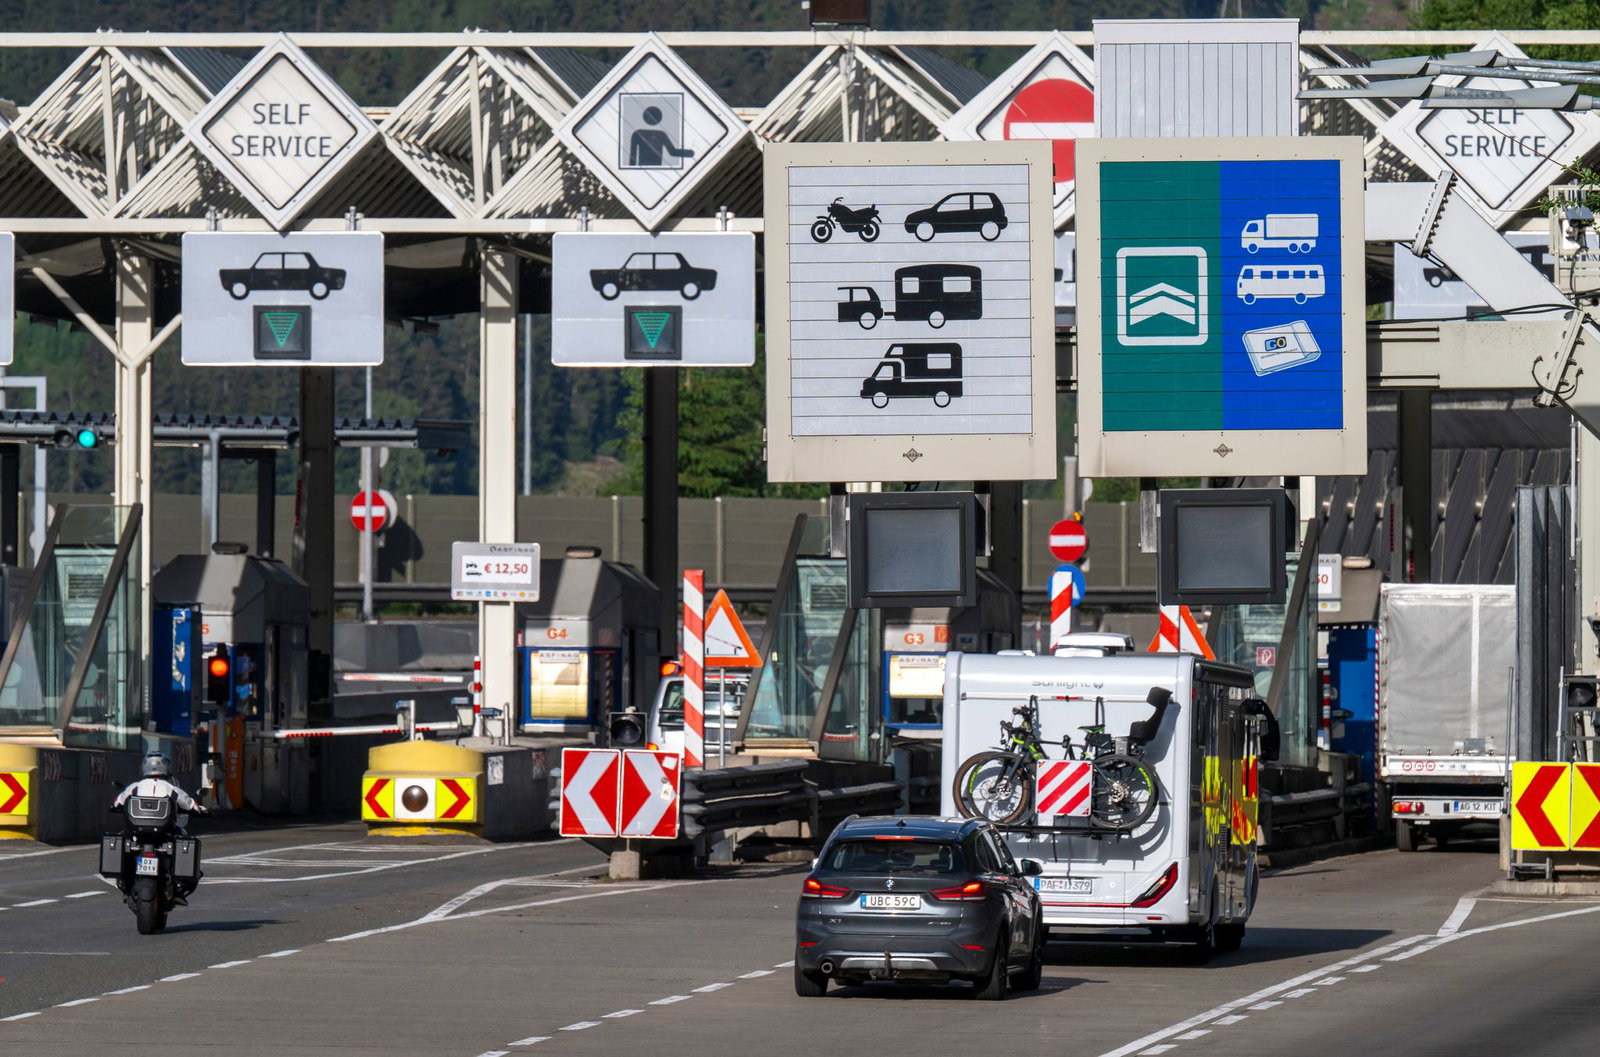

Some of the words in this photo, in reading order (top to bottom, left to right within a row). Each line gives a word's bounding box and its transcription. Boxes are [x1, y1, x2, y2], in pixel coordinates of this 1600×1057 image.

[253, 103, 311, 125] SELF
[1467, 108, 1524, 124] SELF
[231, 134, 332, 157] SERVICE
[1445, 134, 1546, 157] SERVICE
[1265, 337, 1287, 351] GO
[484, 563, 492, 574] €
[495, 563, 528, 575] 12,50
[547, 627, 567, 639] G4
[904, 632, 925, 645] G3
[870, 896, 891, 906] UBC
[894, 896, 916, 907] 59C
